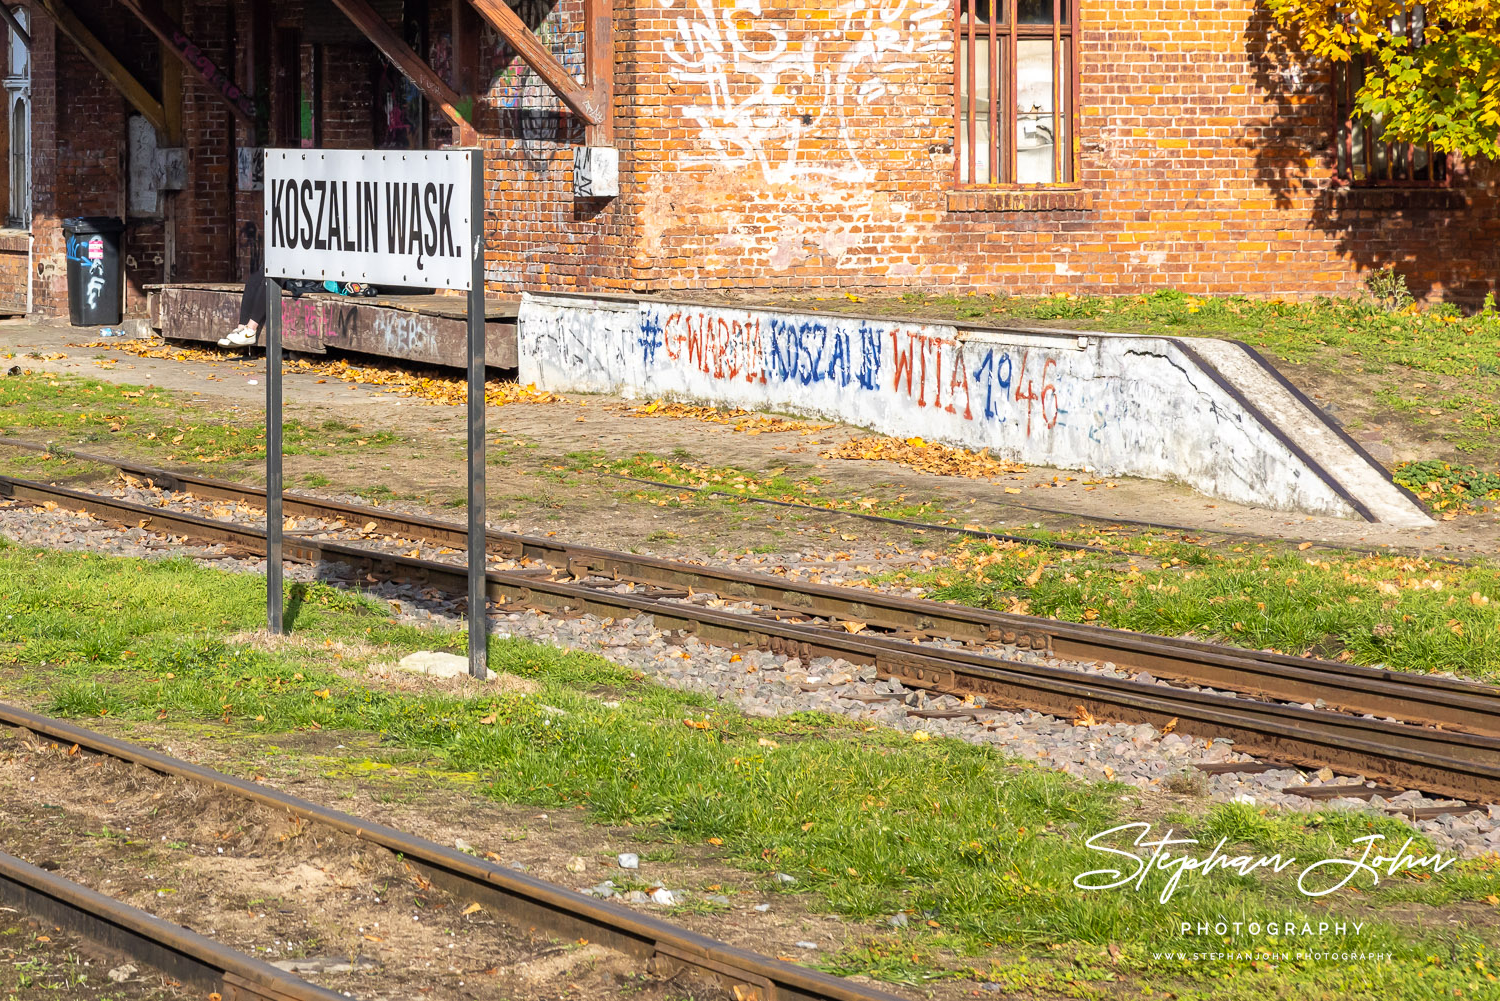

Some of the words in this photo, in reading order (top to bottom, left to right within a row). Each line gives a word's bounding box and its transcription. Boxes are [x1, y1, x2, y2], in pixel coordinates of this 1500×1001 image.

[271, 178, 379, 253] KOSZALIN
[385, 182, 462, 270] WĄSK.
[973, 348, 1059, 438] 1946
